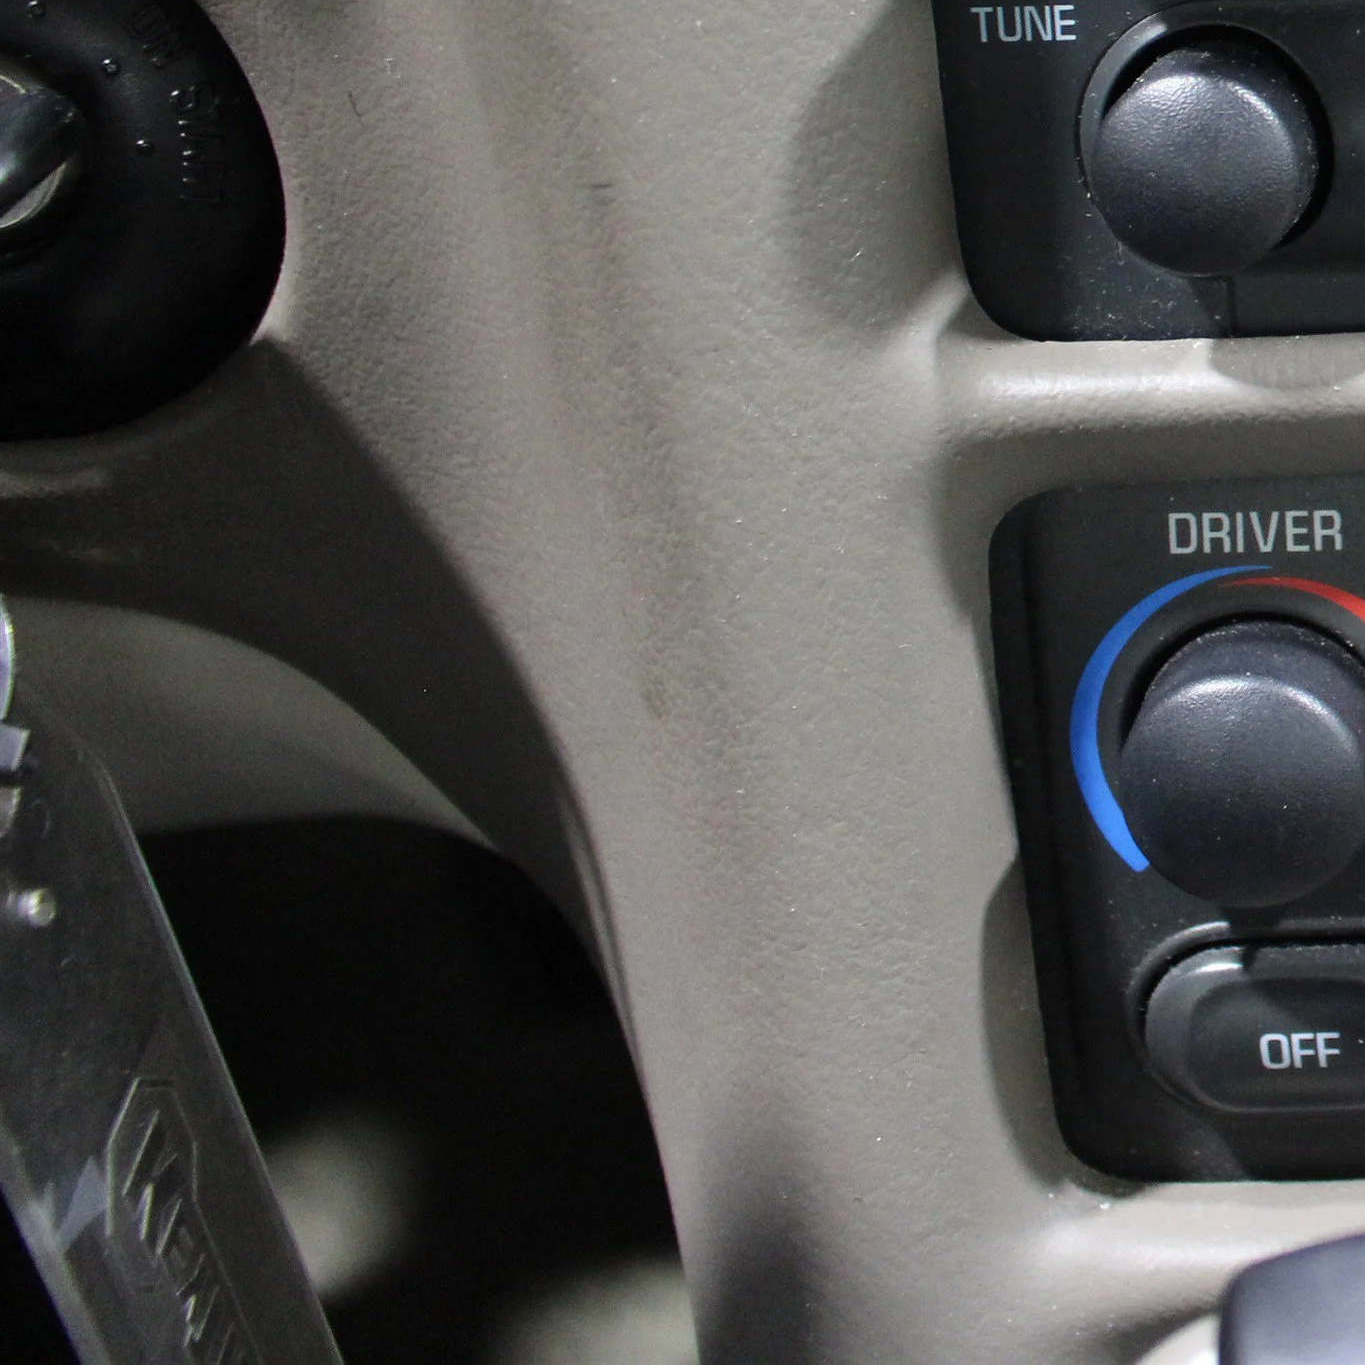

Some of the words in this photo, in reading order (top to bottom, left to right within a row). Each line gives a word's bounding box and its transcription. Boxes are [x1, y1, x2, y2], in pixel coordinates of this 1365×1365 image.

[971, 3, 1078, 43] TUNE
[1168, 509, 1343, 555] DRIVER
[1259, 1031, 1340, 1069] OFF
